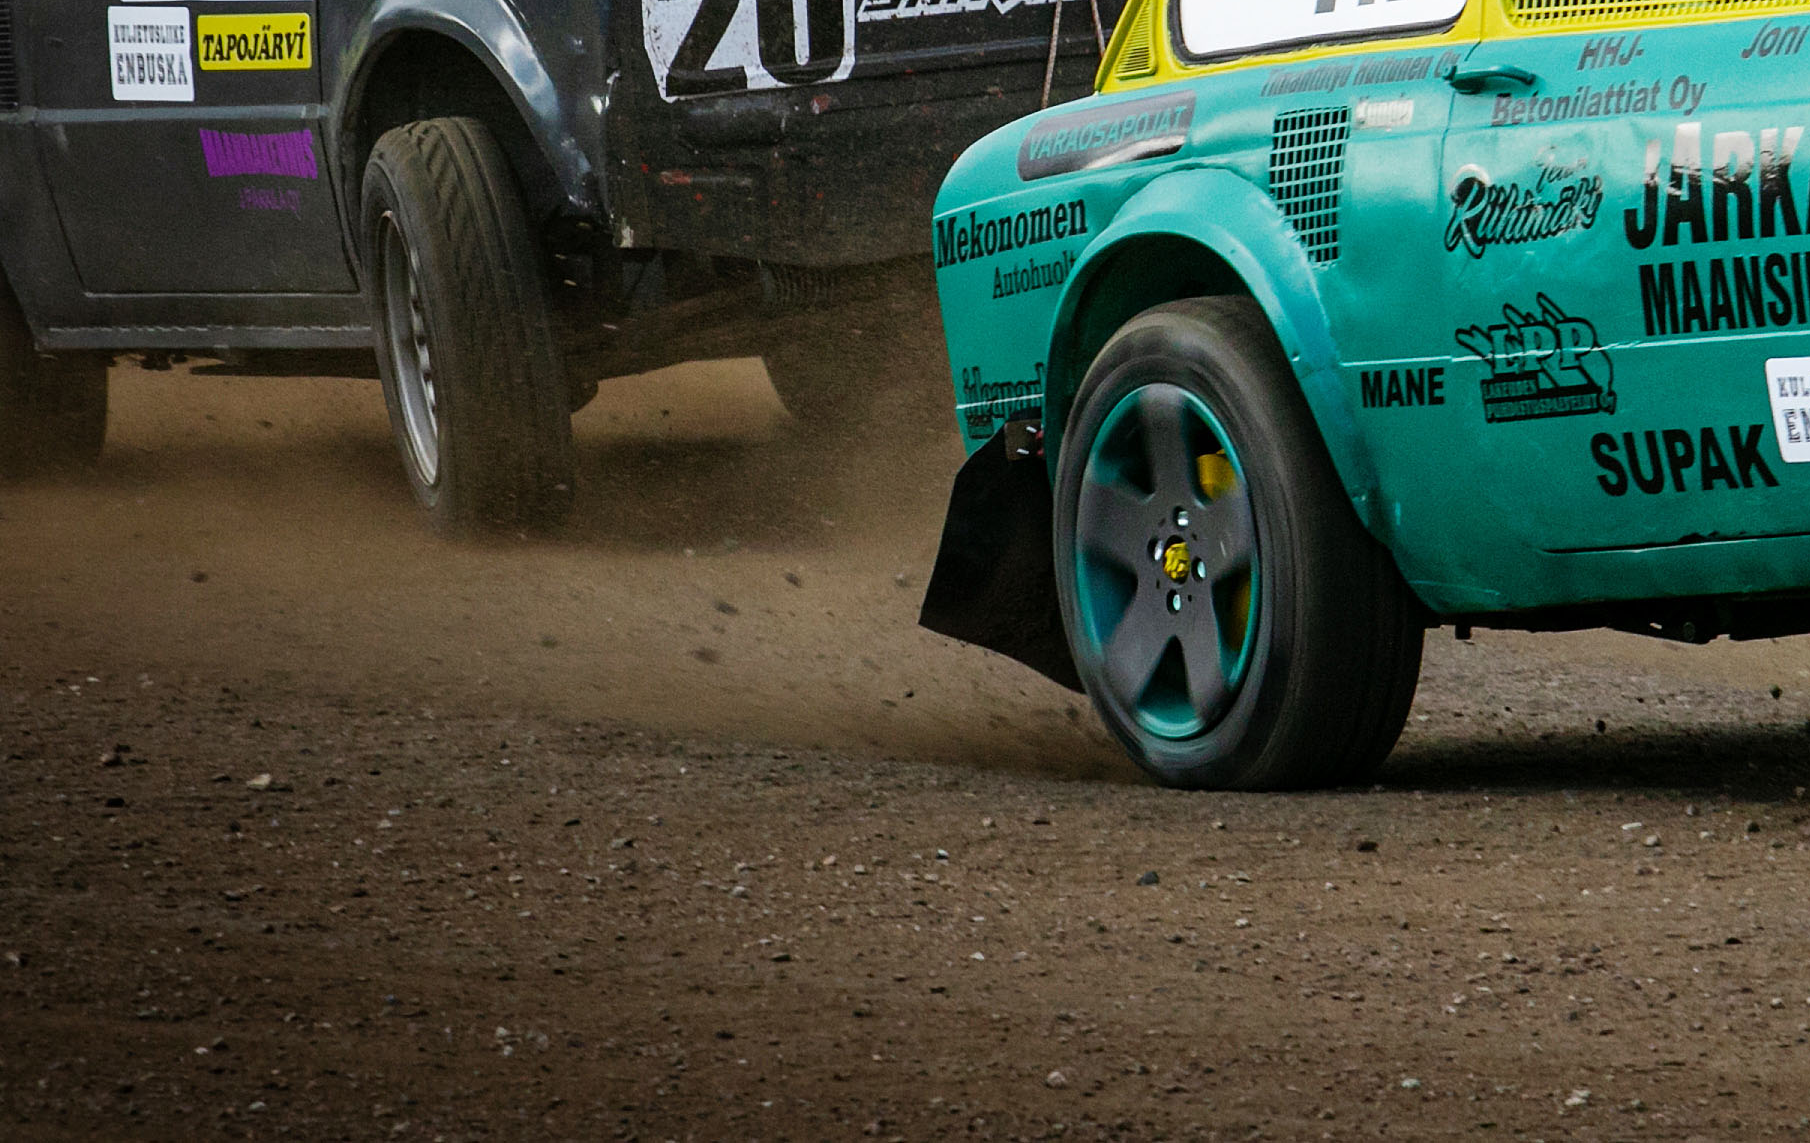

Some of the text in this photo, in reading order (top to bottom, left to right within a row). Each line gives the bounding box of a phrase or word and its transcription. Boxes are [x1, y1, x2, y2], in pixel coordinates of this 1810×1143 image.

[116, 52, 188, 86] ENBUSKA
[1491, 74, 1708, 127] Betonilattiat Oy
[1029, 105, 1187, 160] VARAOSAPOJAT
[936, 199, 1088, 269] Mekonomen
[1361, 367, 1446, 408] MANE
[1590, 424, 1780, 497] SUPAK
